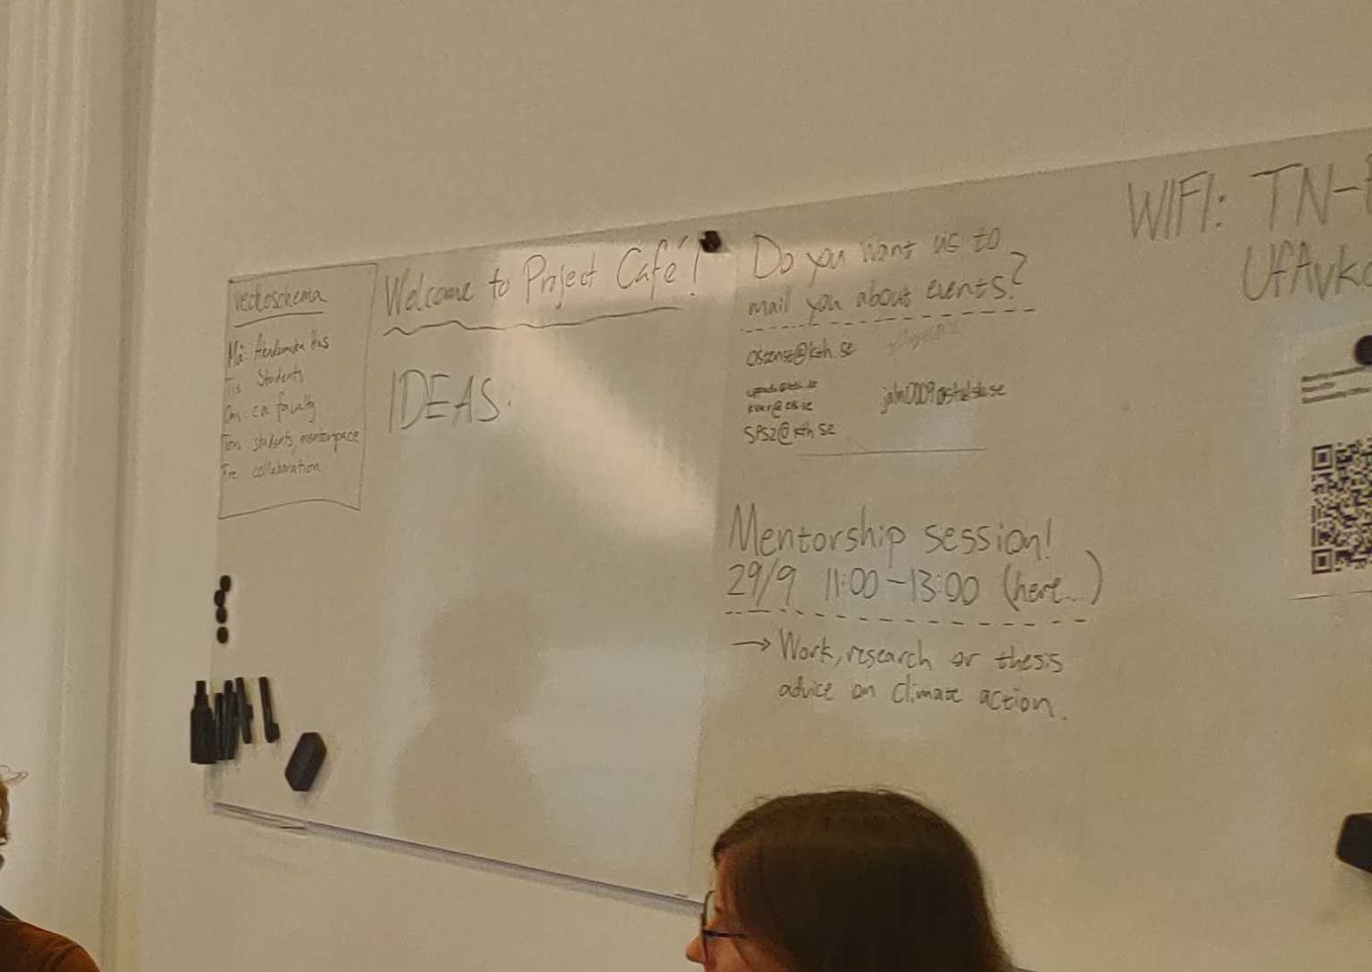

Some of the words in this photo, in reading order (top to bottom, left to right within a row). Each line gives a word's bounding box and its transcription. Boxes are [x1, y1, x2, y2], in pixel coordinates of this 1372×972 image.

[1127, 170, 1228, 241] WIFI:
[752, 233, 794, 280] Do
[806, 247, 846, 287] you
[933, 230, 960, 255] us
[972, 226, 1003, 253] to
[383, 268, 476, 317] Welcome
[488, 268, 511, 298] to
[521, 254, 599, 310] Project
[747, 289, 792, 317] mail
[805, 296, 842, 324] you
[856, 280, 914, 309] about
[729, 502, 906, 568] Mentorship
[924, 515, 1055, 561] session!
[728, 560, 797, 606] 29/9
[950, 650, 981, 669] or
[993, 642, 1065, 673] thesis
[777, 675, 836, 702] advice
[851, 681, 878, 701] on
